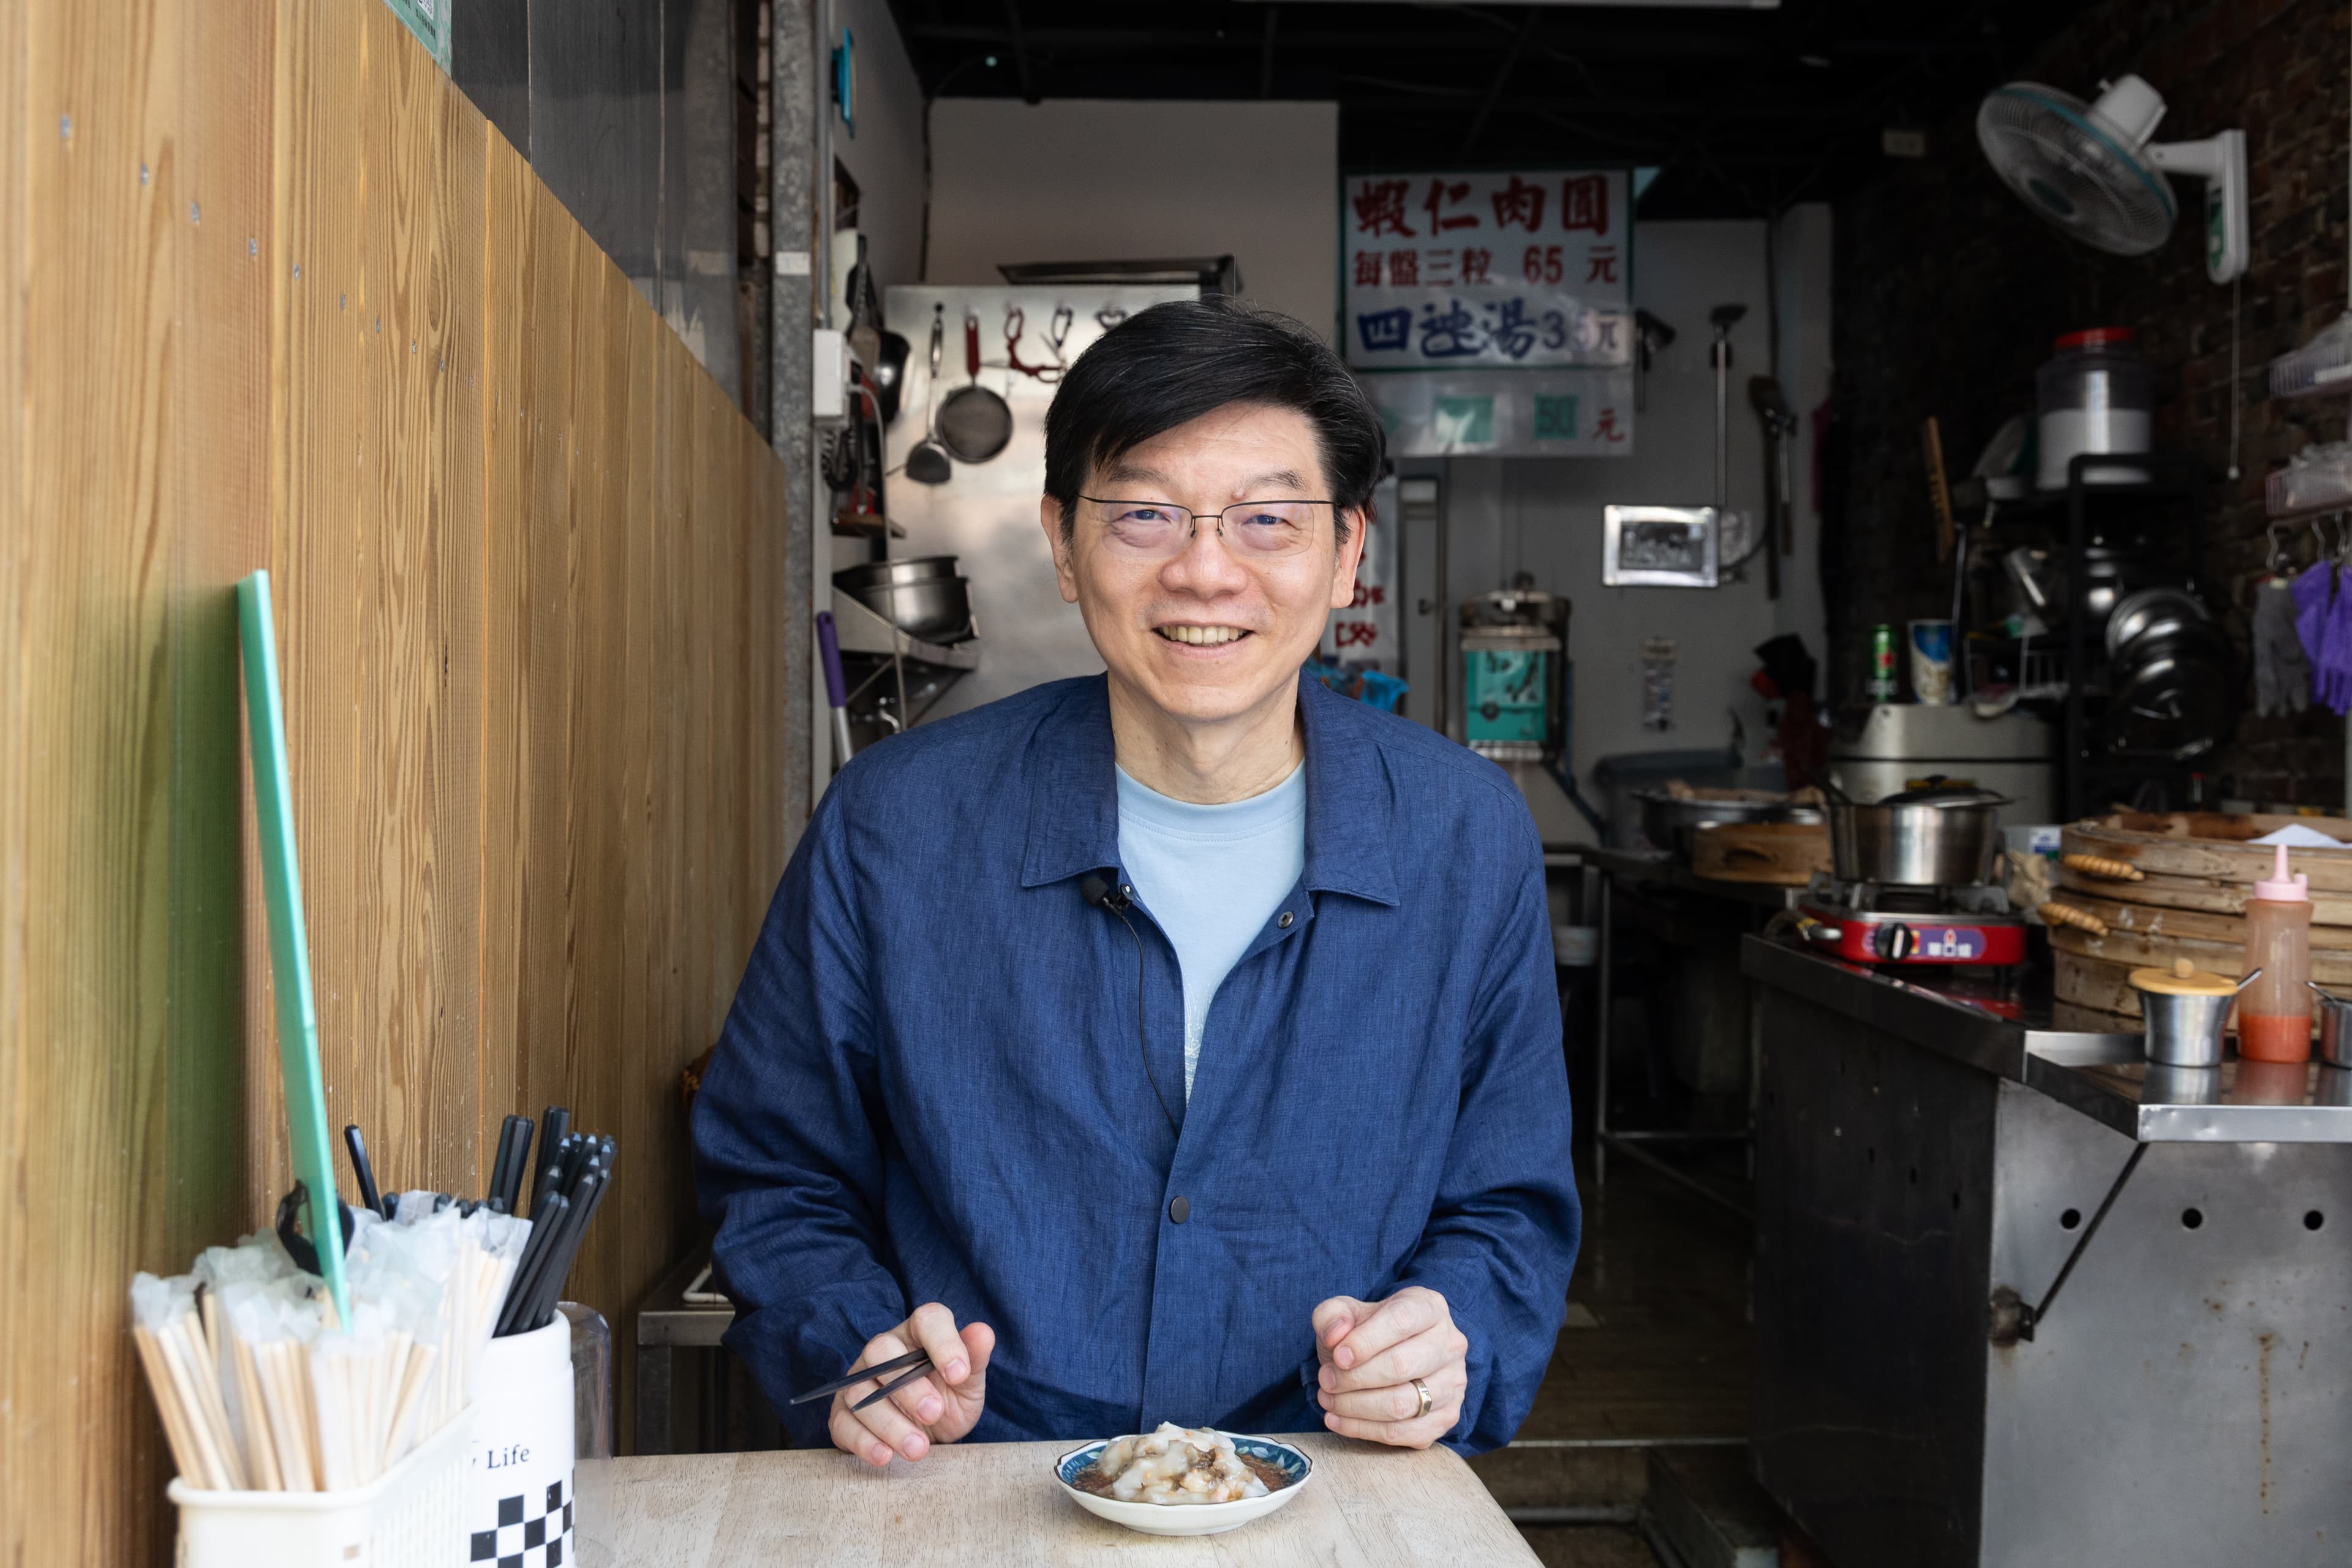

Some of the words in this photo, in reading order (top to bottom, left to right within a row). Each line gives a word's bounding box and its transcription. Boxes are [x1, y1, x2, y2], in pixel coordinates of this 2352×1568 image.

[1353, 175, 1610, 238] 蝦仁肉圓
[1523, 246, 1563, 285] 65
[1587, 246, 1618, 284] 元
[487, 1443, 530, 1470] Life
